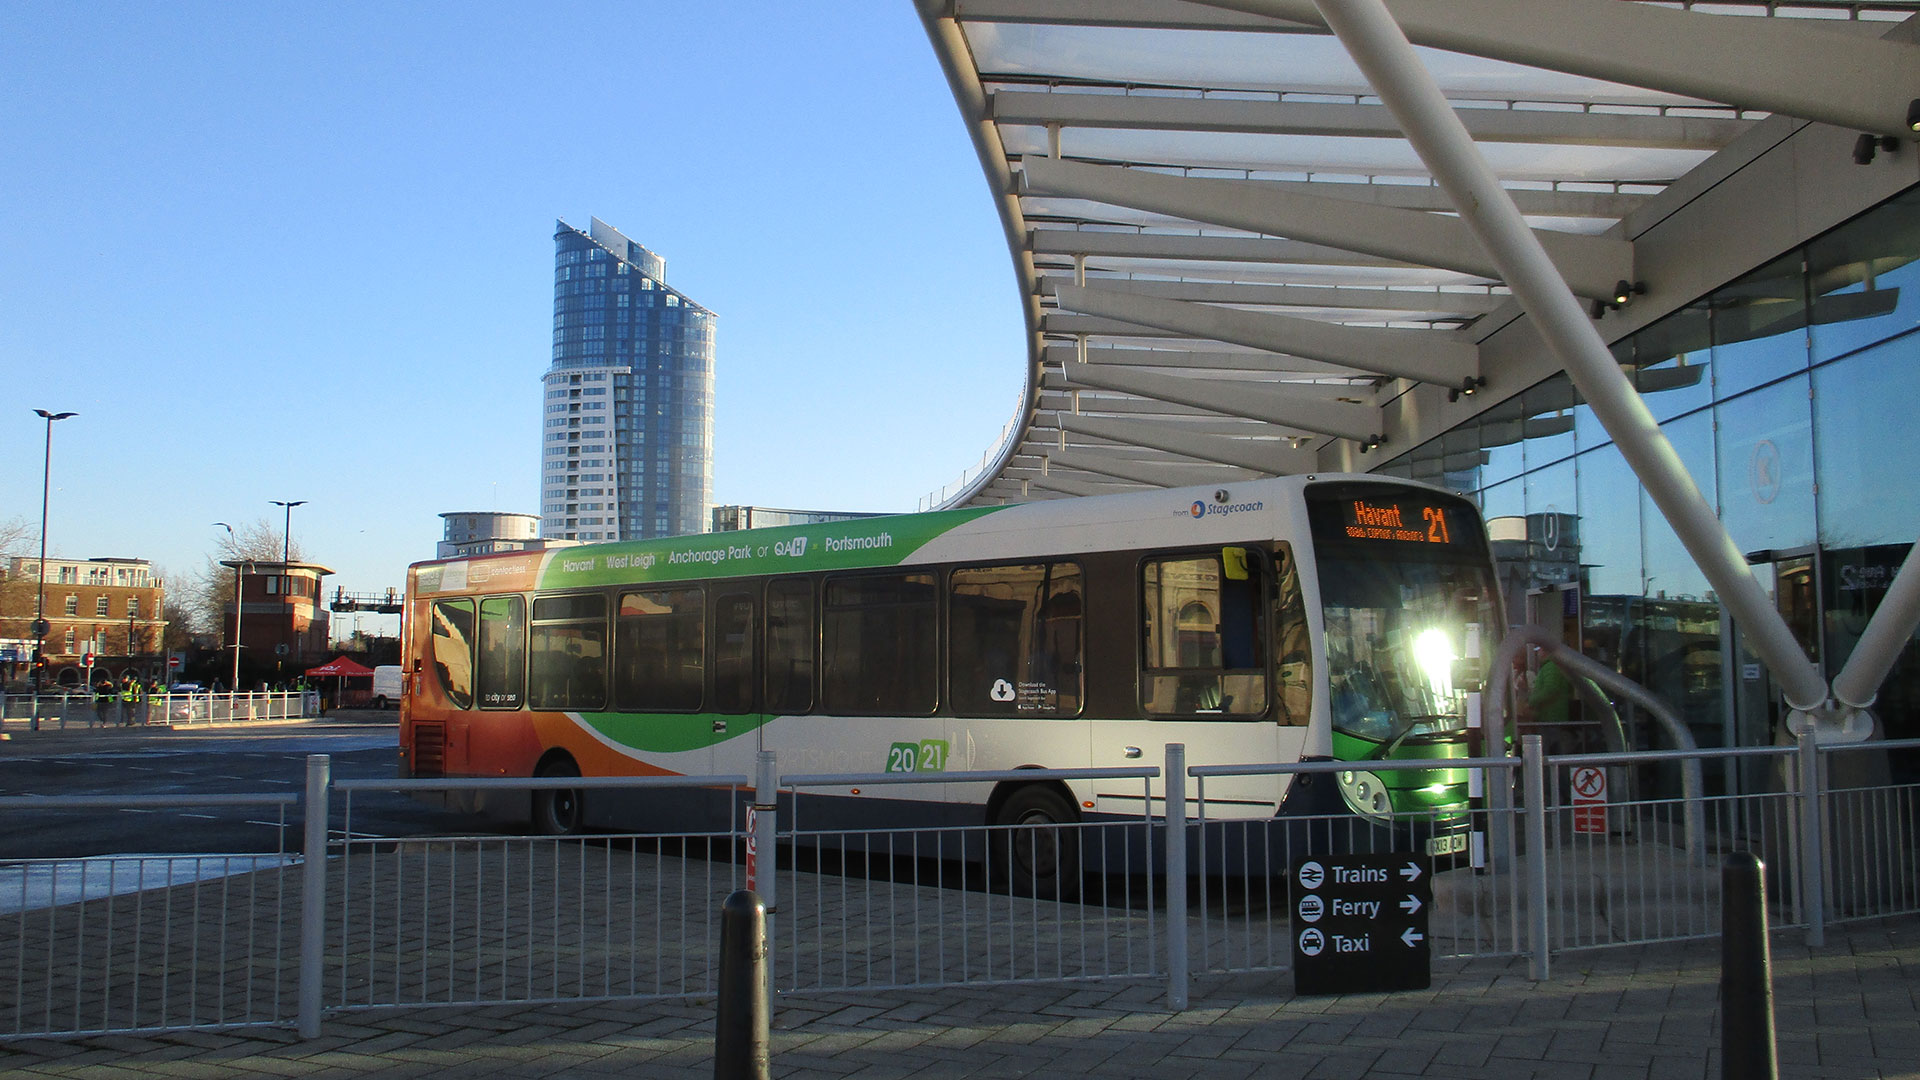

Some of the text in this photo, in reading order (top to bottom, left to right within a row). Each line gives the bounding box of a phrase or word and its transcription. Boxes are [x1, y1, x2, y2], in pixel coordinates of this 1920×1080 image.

[1207, 501, 1263, 517] Stagecoach
[1353, 500, 1403, 528] Havant
[1422, 506, 1450, 543] 21
[563, 558, 594, 573] Havant
[606, 555, 628, 569] West
[630, 553, 656, 570] Leigh
[668, 549, 725, 565] Anchorage
[728, 545, 751, 560] Park
[757, 546, 769, 558] or
[825, 531, 892, 552] Portsmouth
[891, 744, 942, 773] 20 21
[1331, 864, 1388, 884] Trains
[1332, 898, 1380, 920] Ferry
[1331, 933, 1370, 953] Taxi
